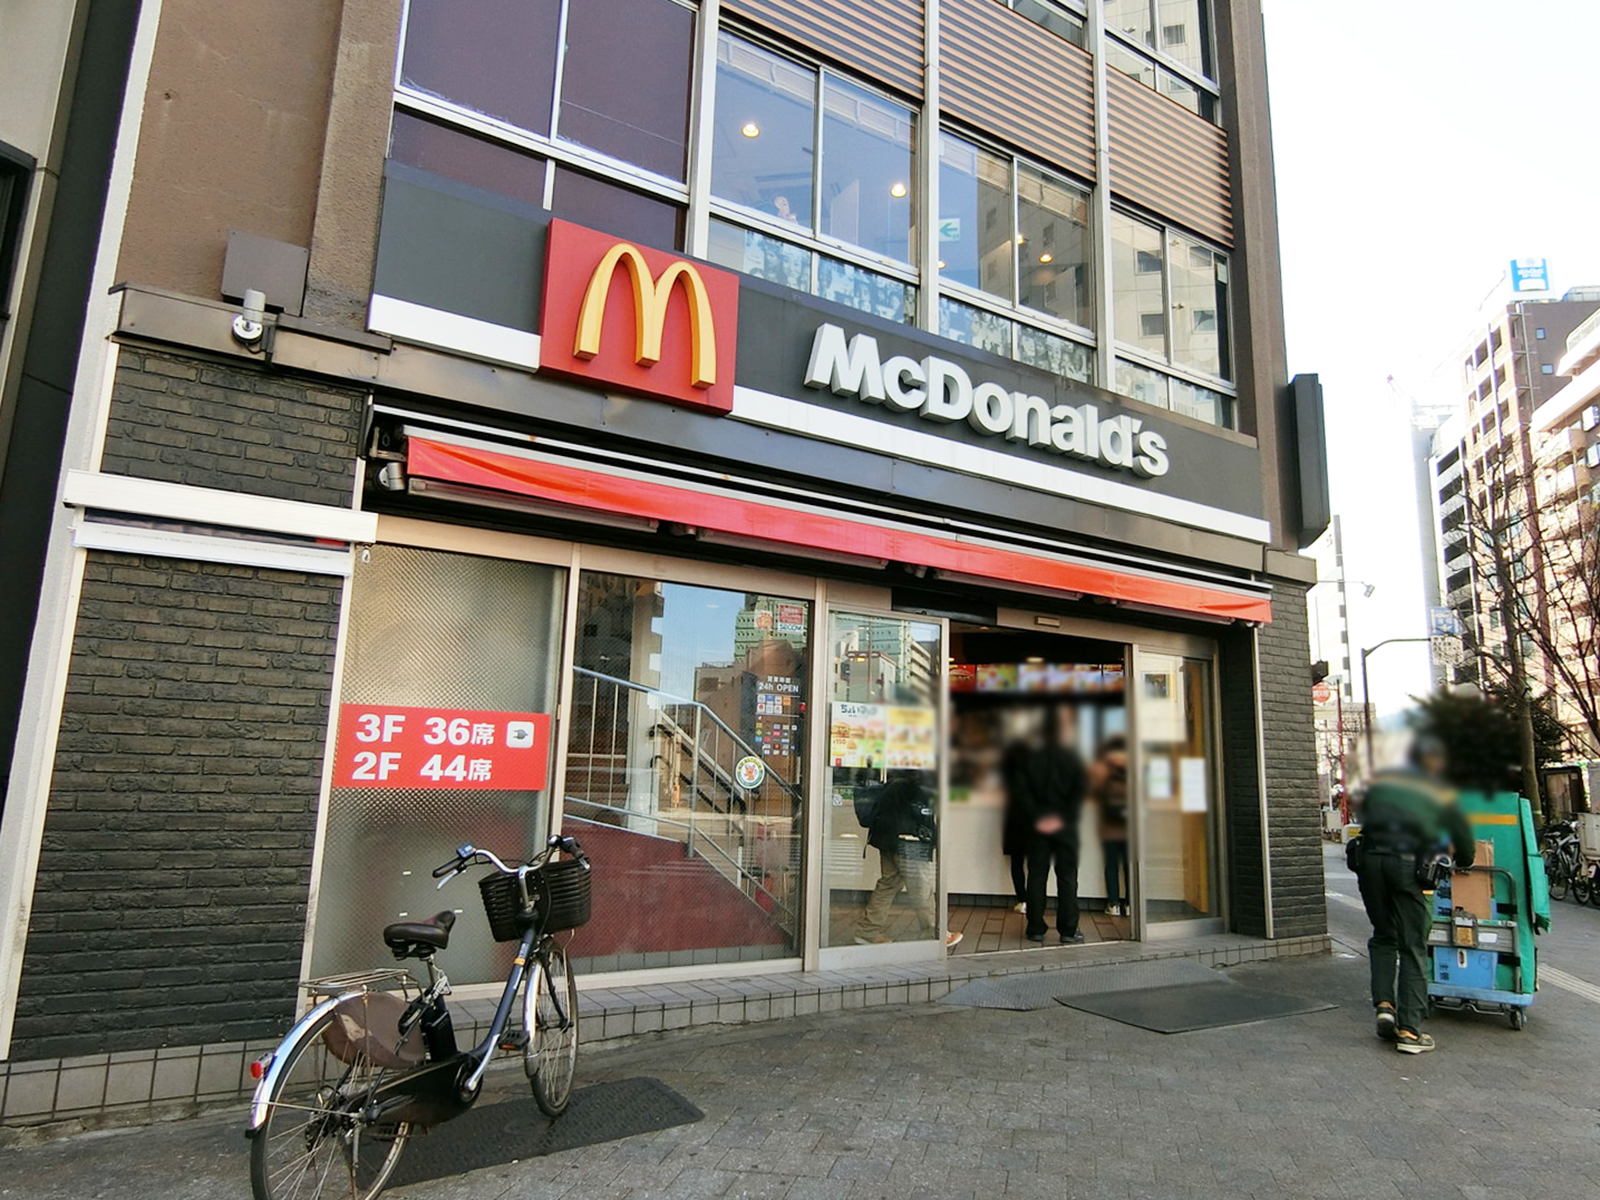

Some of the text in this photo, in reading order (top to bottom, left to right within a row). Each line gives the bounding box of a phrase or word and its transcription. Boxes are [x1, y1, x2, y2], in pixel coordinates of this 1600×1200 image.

[804, 322, 1170, 480] McDonald's
[758, 682, 799, 693] 24h OPEN
[356, 713, 495, 747] 3F 36席
[352, 751, 493, 783] 2F 44席
